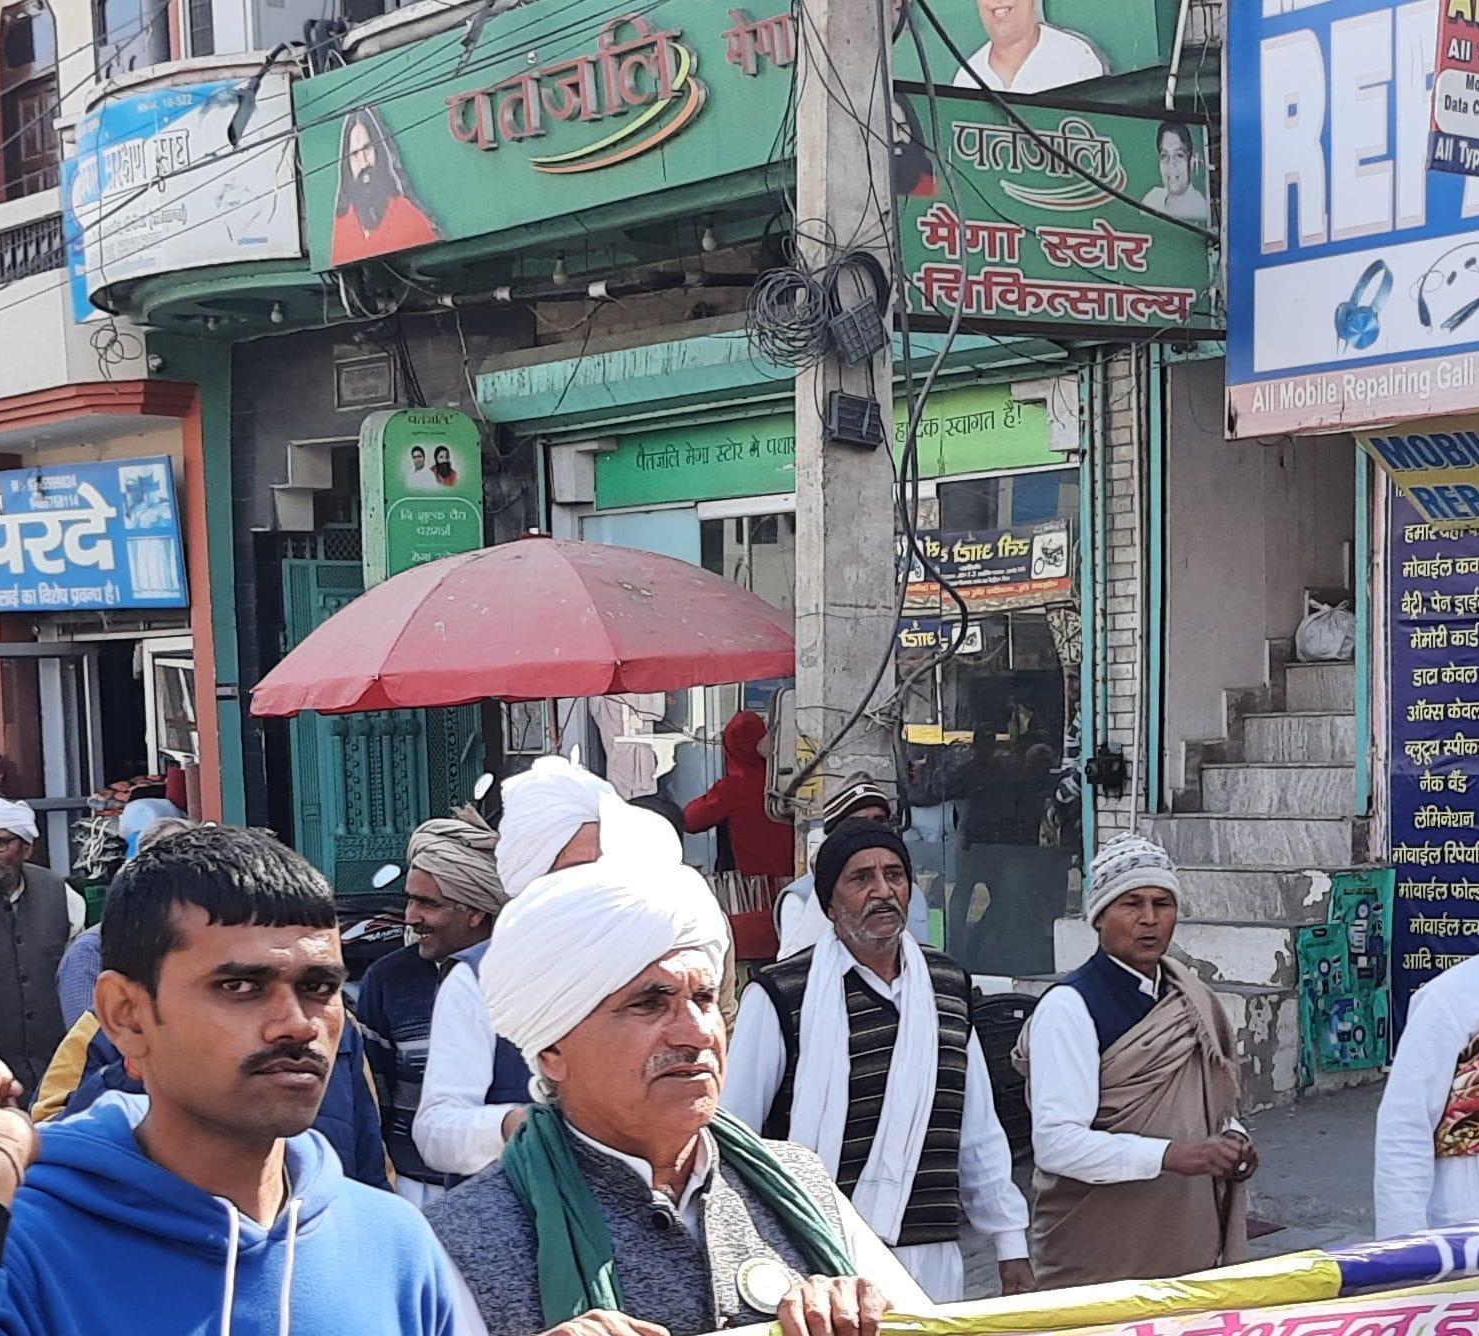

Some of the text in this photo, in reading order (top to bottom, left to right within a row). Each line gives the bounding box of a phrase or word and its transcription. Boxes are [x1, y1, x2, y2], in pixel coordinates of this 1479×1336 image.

[1448, 38, 1471, 62] All
[1444, 95, 1469, 114] Data
[1434, 137, 1453, 160] All
[1251, 385, 1276, 414] All
[1278, 374, 1337, 410] Mobile
[1342, 364, 1431, 404] Repairing
[945, 410, 995, 437] स्वागत
[1450, 622, 1479, 647] कार्ड
[1412, 668, 1438, 687] डाटा
